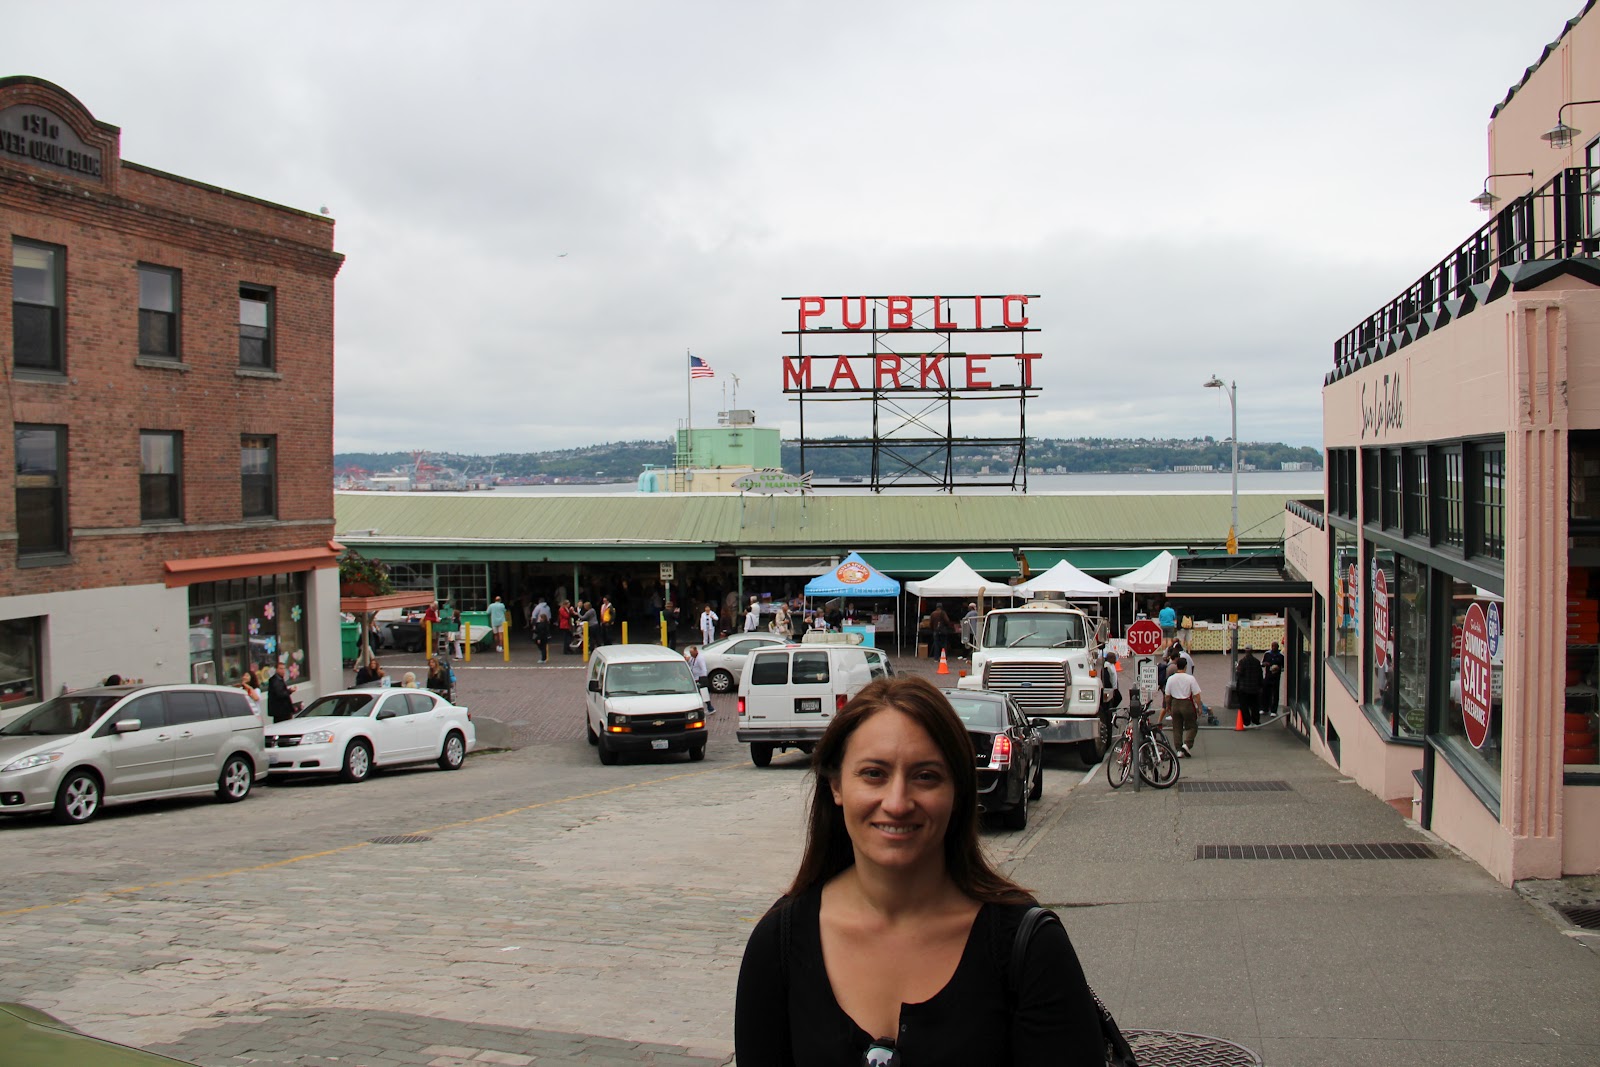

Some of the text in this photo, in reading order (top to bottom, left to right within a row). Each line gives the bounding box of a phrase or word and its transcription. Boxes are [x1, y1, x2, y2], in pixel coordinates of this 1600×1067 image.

[800, 294, 1029, 330] PUBLIC
[783, 353, 1042, 390] MARKET
[1384, 371, 1404, 438] Table
[1129, 631, 1160, 644] STOP
[1375, 605, 1387, 638] SALE
[1465, 631, 1488, 664] SUMMER
[1464, 655, 1488, 707] SALE
